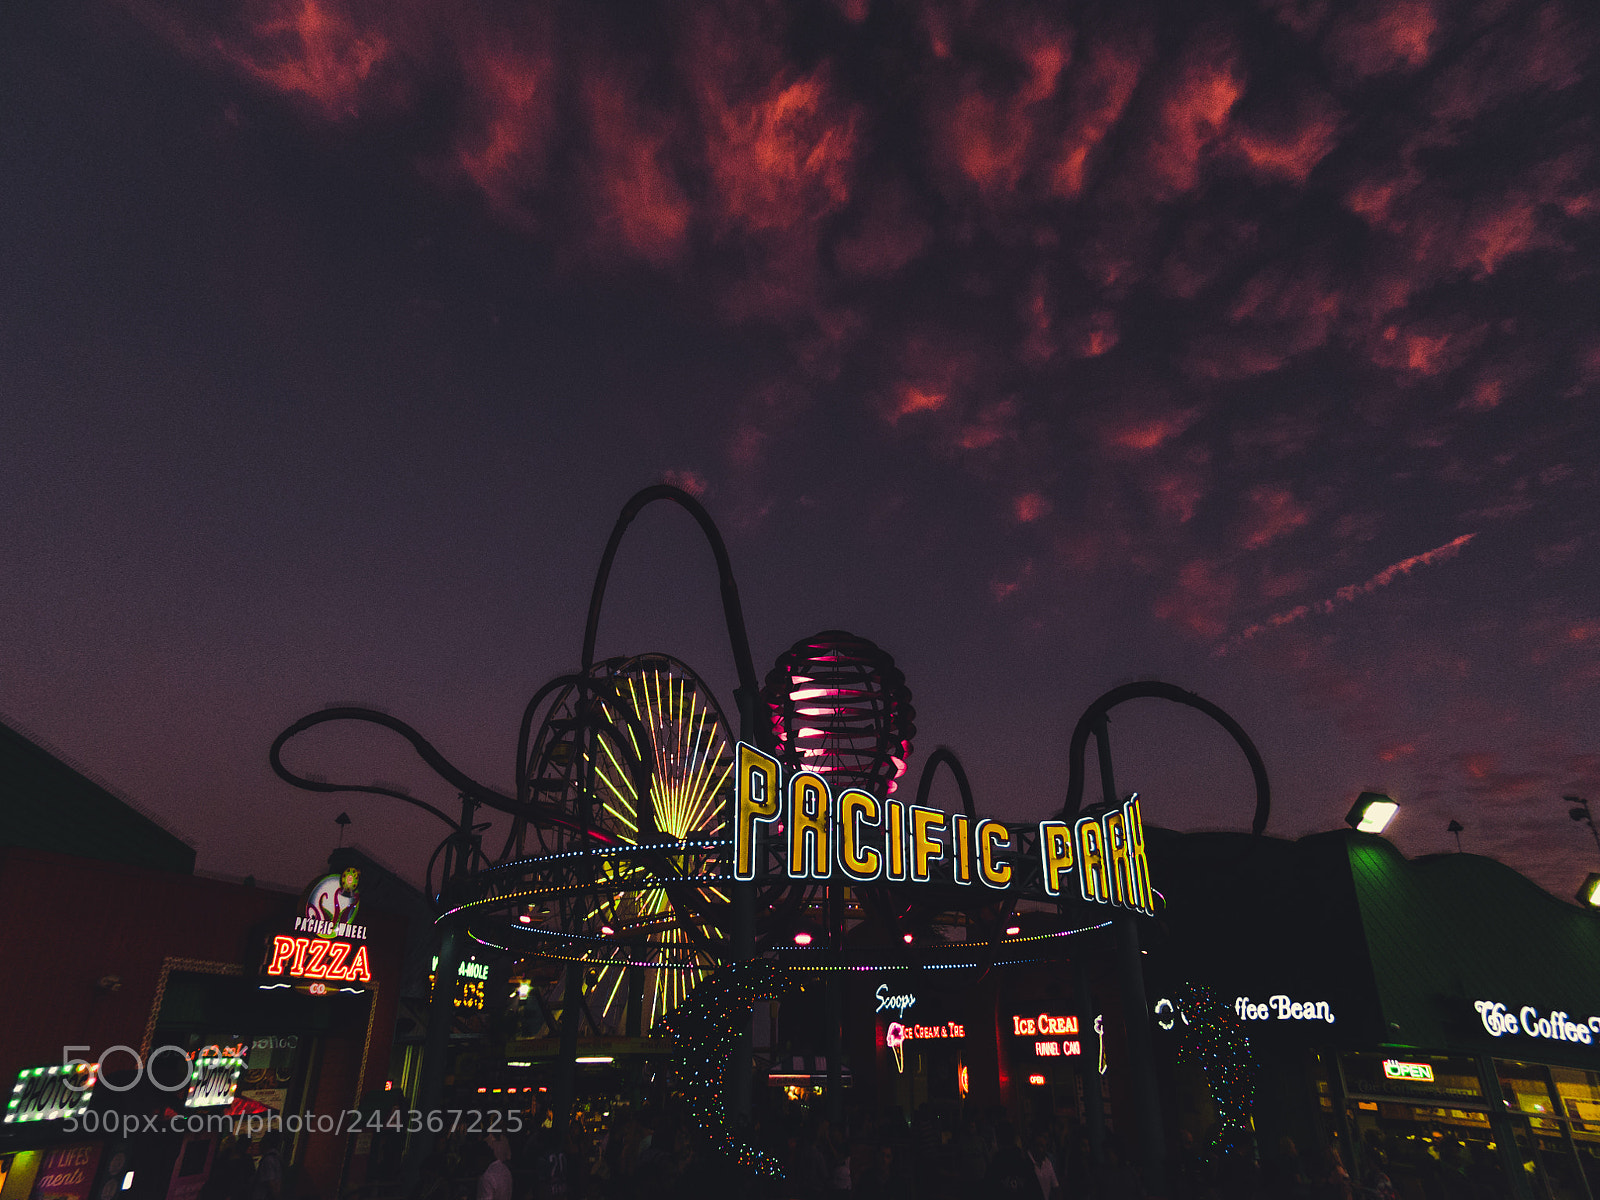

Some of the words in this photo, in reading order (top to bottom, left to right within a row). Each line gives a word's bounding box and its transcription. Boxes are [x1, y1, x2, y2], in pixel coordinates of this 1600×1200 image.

[734, 740, 1012, 889] PACIFIC
[1039, 792, 1155, 917] PARK
[294, 916, 334, 936] PACIFIC
[337, 922, 367, 940] WHEEL
[267, 934, 372, 982] PIZZA
[875, 983, 916, 1019] Scoops
[1268, 994, 1336, 1023] Bean
[914, 1023, 940, 1040] CREAM
[947, 1020, 966, 1039] TRE
[1012, 1015, 1036, 1035] ICE
[1473, 1000, 1520, 1037] The
[1519, 1005, 1593, 1045] Coffee
[1034, 1041, 1061, 1056] FUNNEL
[1386, 1063, 1432, 1080] OPEN
[16, 1074, 88, 1113] PHOTOS
